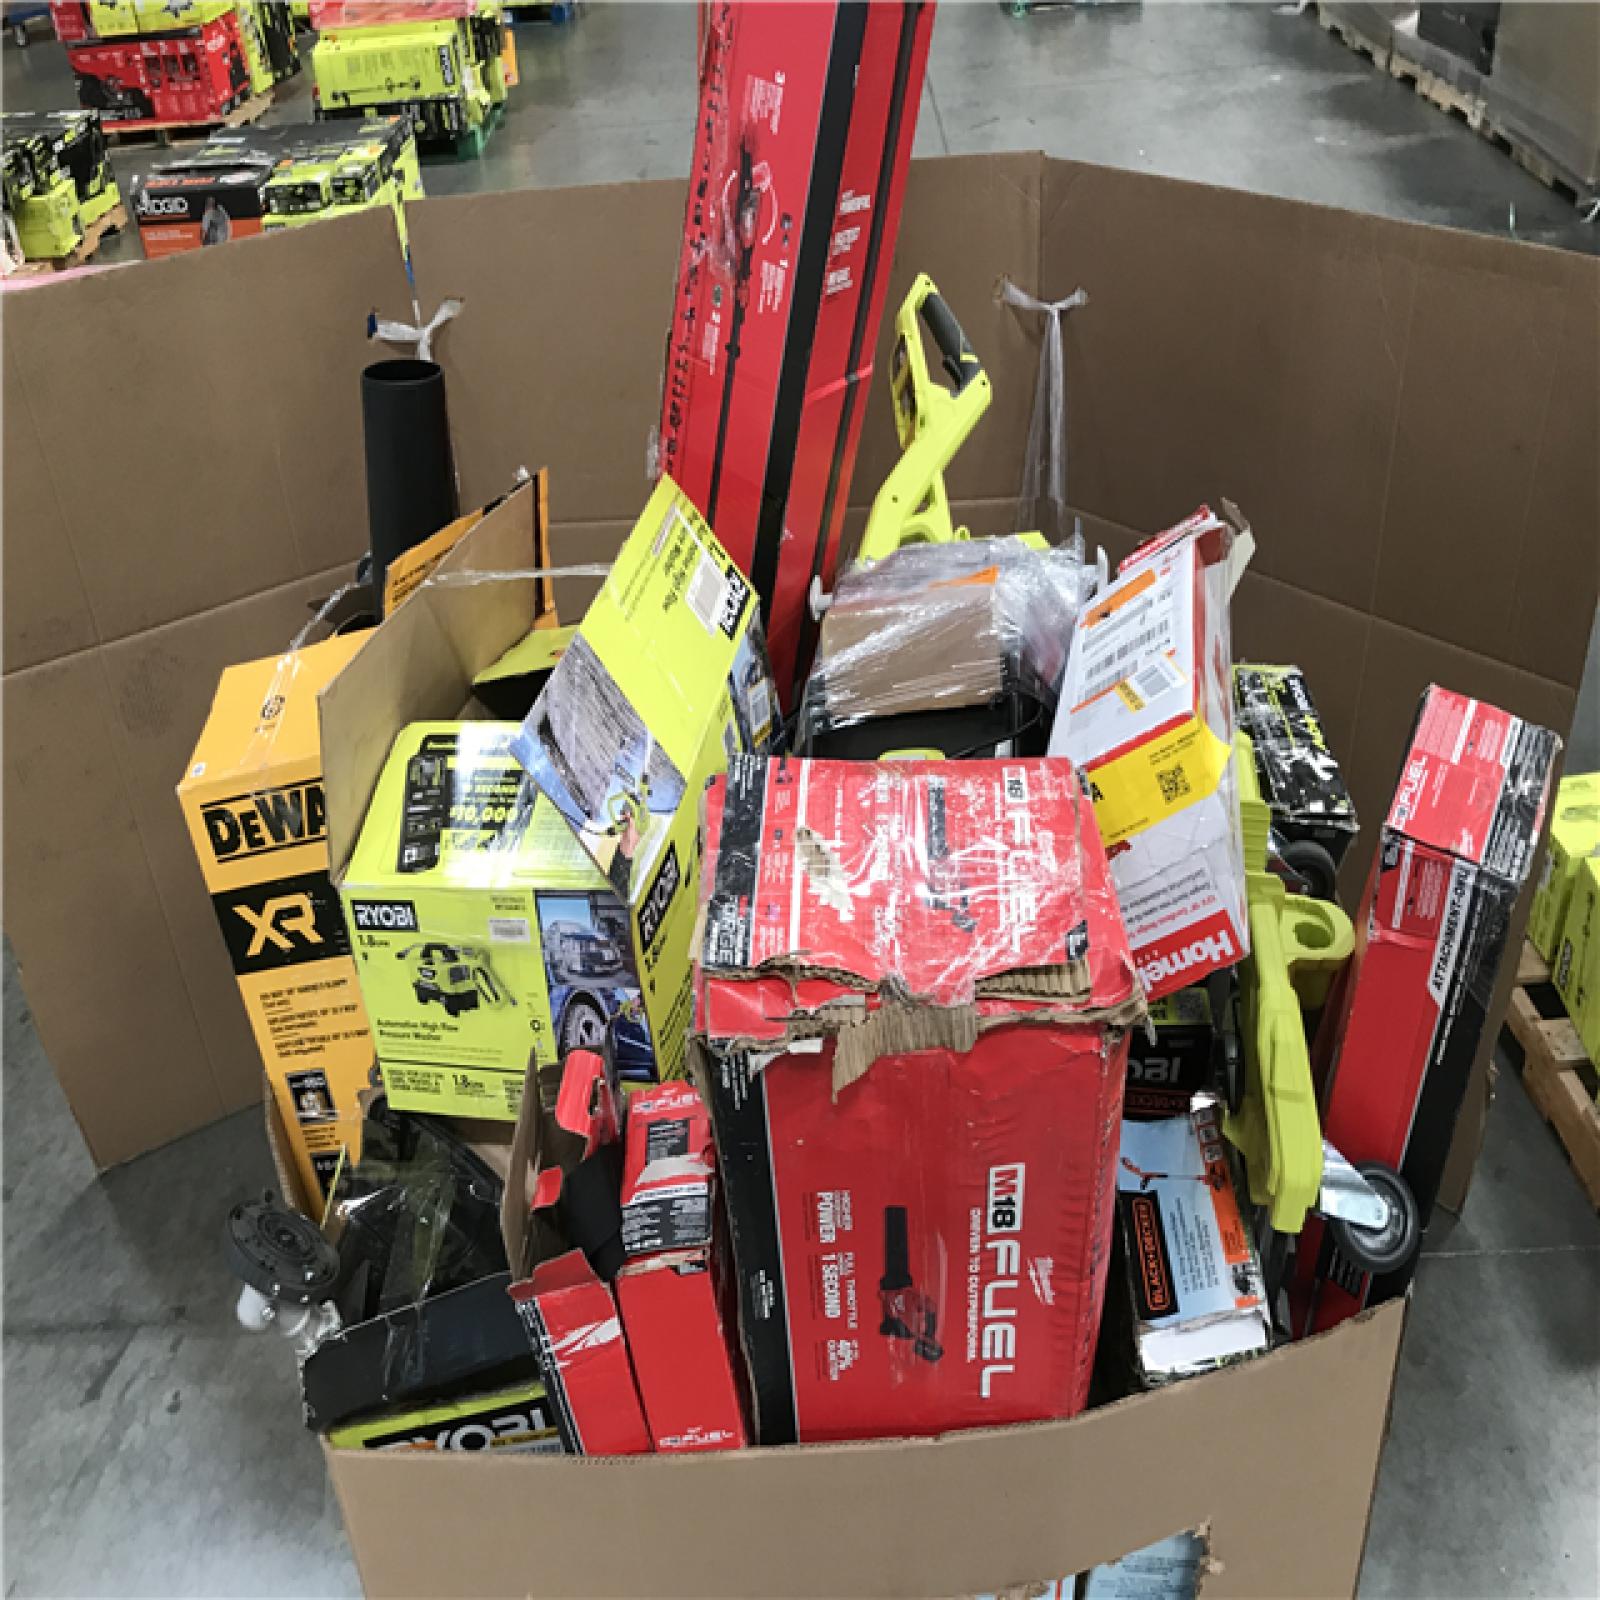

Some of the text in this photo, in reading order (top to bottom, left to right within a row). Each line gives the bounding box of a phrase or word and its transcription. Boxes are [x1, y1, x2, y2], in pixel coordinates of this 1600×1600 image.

[1399, 753, 1427, 805] FUEL
[232, 893, 325, 957] XR
[354, 904, 414, 927] RYOBI
[980, 1165, 1022, 1398] M18 FUEL
